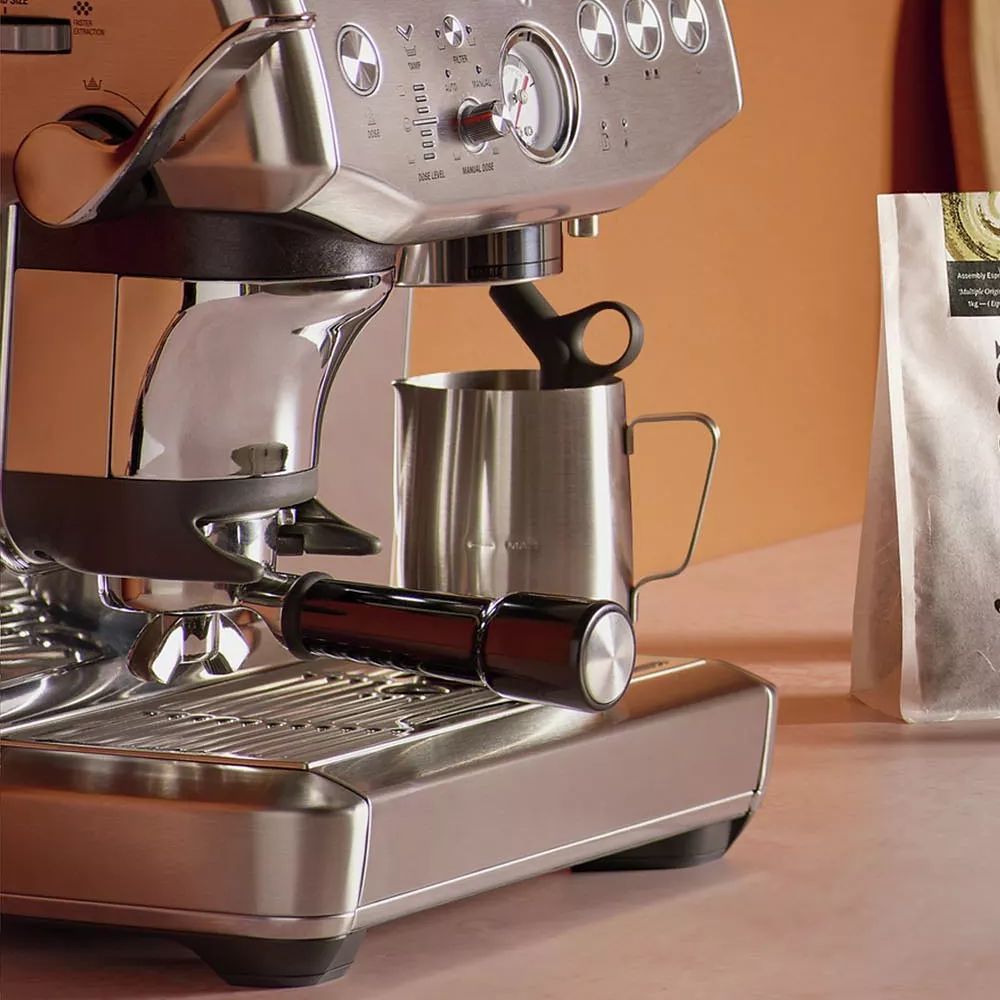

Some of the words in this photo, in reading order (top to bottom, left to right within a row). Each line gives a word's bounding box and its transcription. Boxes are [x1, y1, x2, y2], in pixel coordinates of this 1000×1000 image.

[462, 164, 481, 174] MANUAL
[482, 162, 494, 172] DOSE
[957, 271, 986, 280] Assembly
